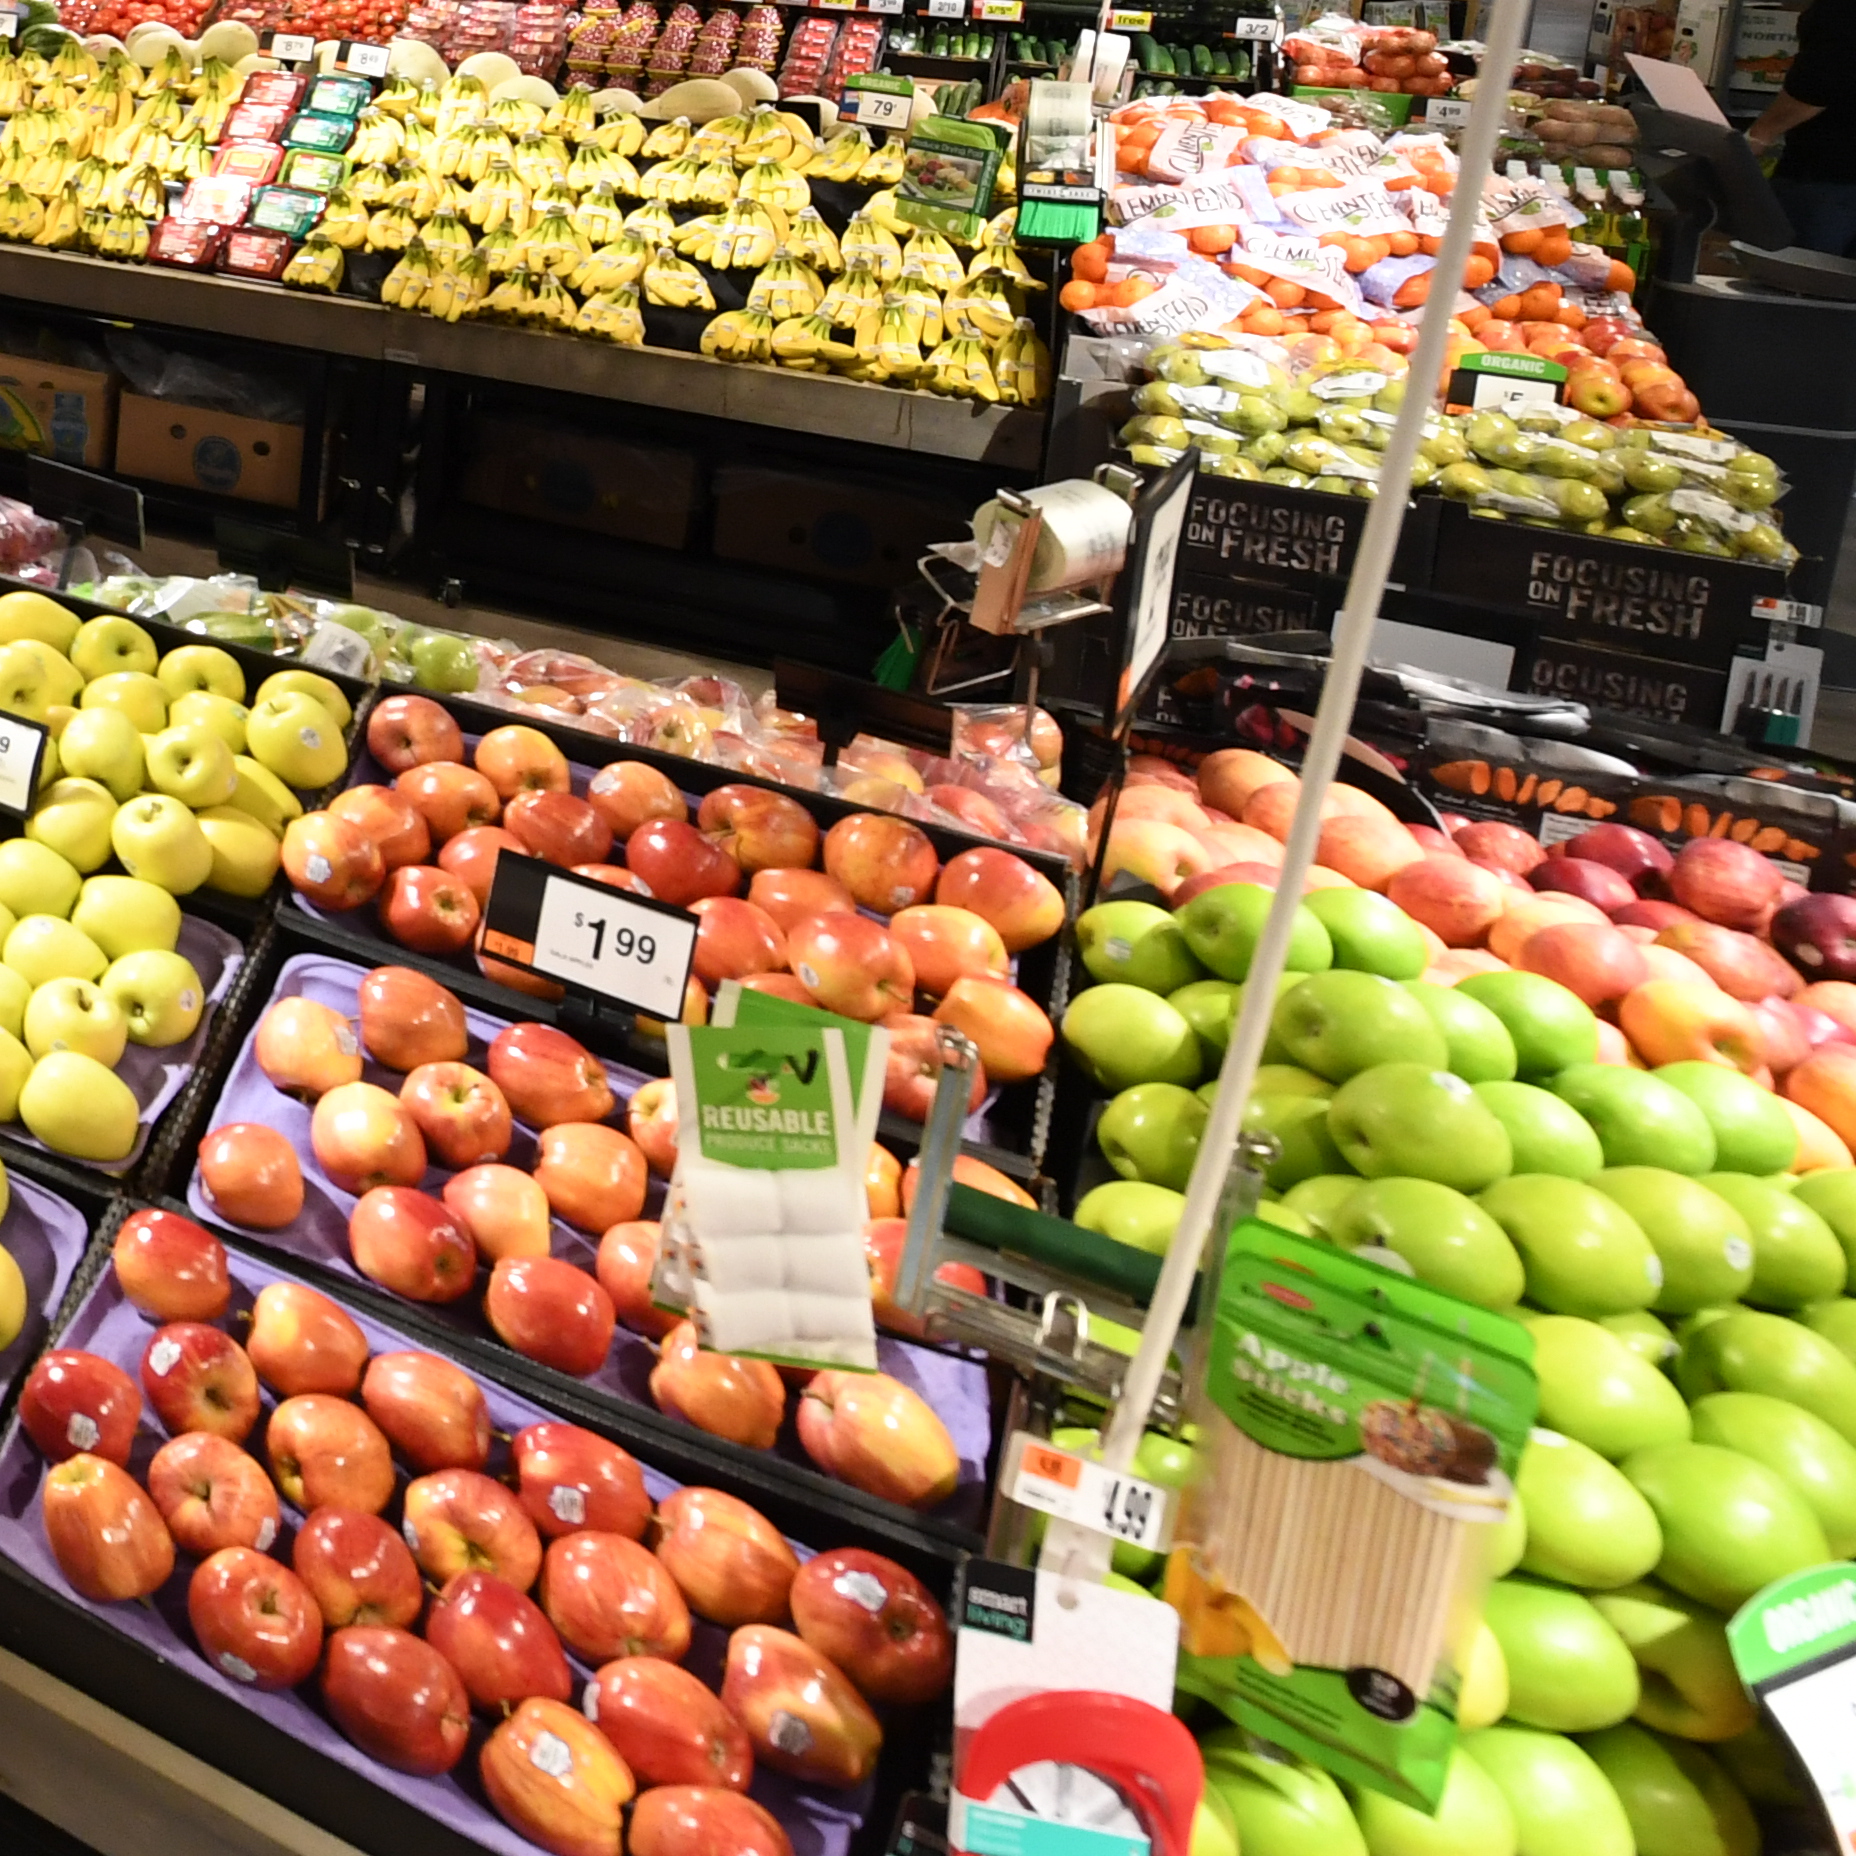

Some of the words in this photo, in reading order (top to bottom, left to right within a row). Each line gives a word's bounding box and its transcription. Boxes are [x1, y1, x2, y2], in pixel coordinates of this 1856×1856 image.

[1118, 14, 1145, 25] free
[1481, 354, 1545, 374] ORGANIC
[1190, 496, 1345, 543] FOCUSING
[1188, 522, 1216, 543] ON
[1220, 527, 1339, 575] FRESH
[1529, 551, 1710, 606] FOCUSING
[1174, 592, 1308, 633] FOCUSIN
[1528, 580, 1561, 604] ON
[1566, 587, 1704, 640] FRESH
[1532, 658, 1687, 713] OCUSING
[702, 1104, 830, 1136] REUSABLE
[1238, 1333, 1348, 1394] Apple
[1233, 1356, 1348, 1425] Sticks
[967, 1604, 1027, 1641] living
[968, 1586, 1028, 1617] smart
